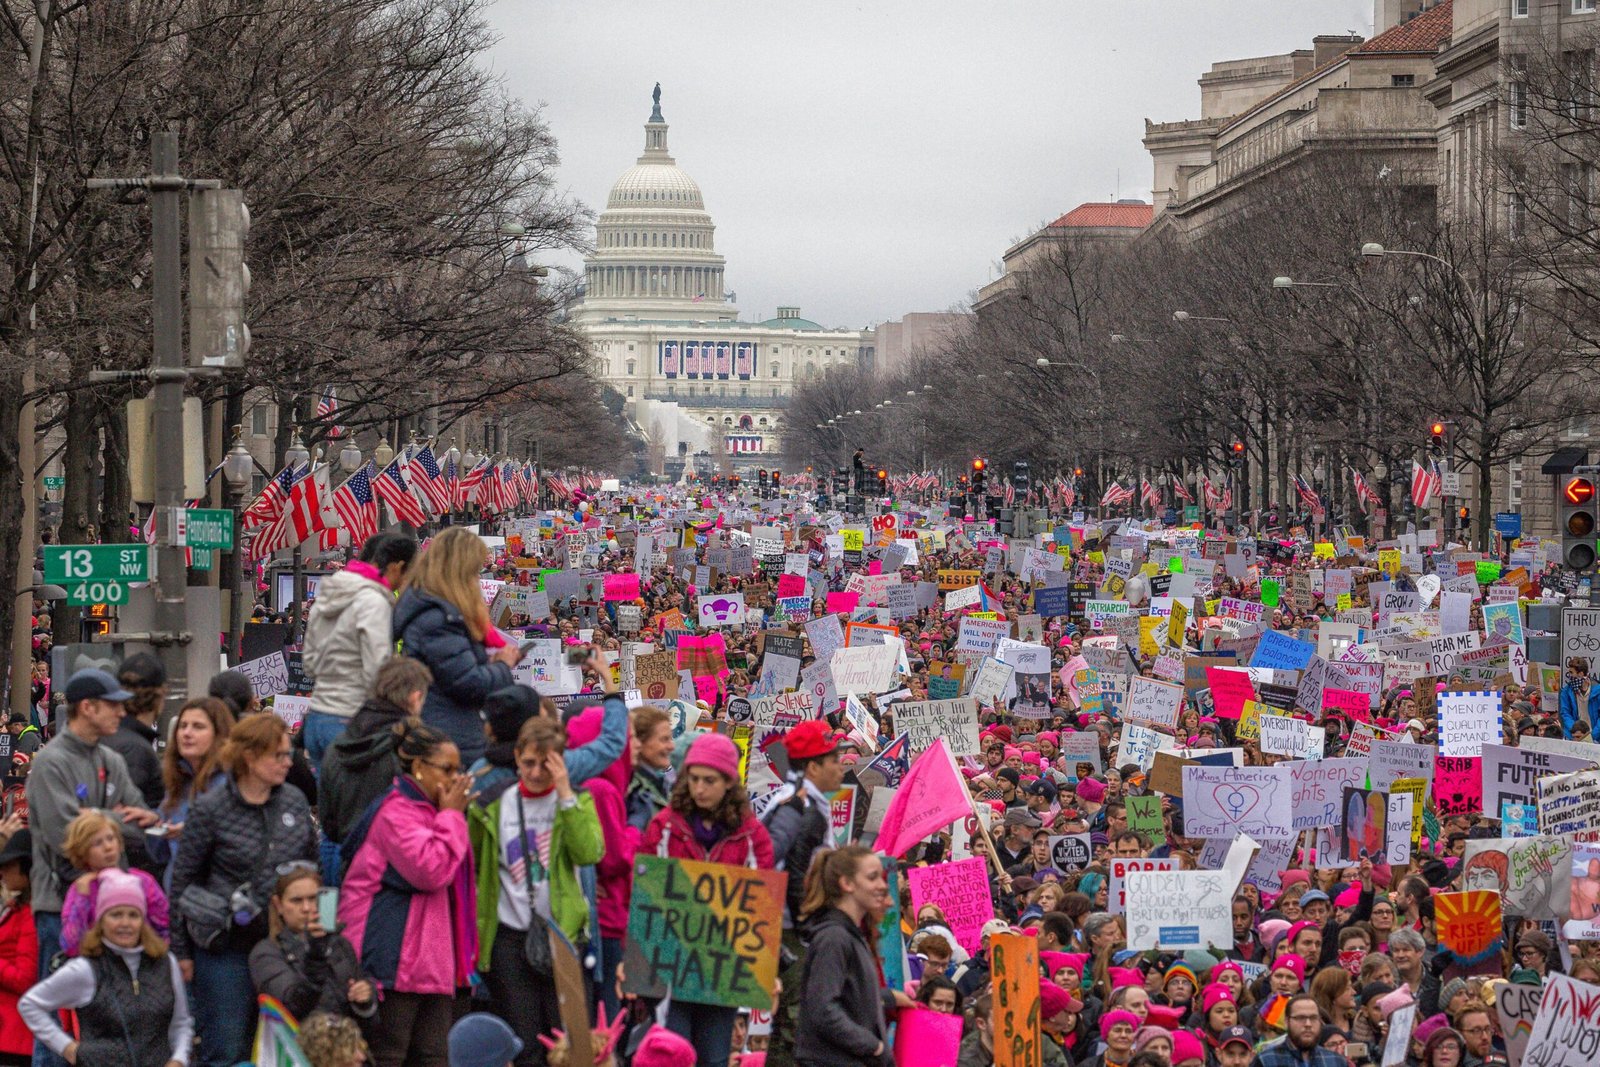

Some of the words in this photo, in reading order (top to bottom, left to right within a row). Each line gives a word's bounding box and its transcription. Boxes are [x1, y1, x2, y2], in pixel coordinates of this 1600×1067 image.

[46, 477, 54, 485] 12
[872, 514, 896, 532] HO
[59, 549, 94, 578] 13
[120, 550, 140, 562] ST
[194, 549, 210, 567] 1300
[765, 555, 786, 563] RESIST
[1110, 560, 1130, 570] GRAB
[120, 564, 142, 575] NW
[938, 575, 979, 586] RESIST
[1356, 572, 1382, 584] LOVE
[73, 582, 122, 602] 400
[782, 597, 810, 605] FREEDOM
[1087, 602, 1129, 613] PATRIARCHY
[1222, 598, 1241, 609] WE
[1244, 603, 1263, 614] ARE
[1228, 608, 1257, 622] BETTER
[1566, 613, 1598, 627] THRU
[966, 620, 1006, 630] AMERICANS
[964, 628, 980, 638] WILL
[622, 643, 638, 656] THE
[774, 637, 794, 648] HATE
[966, 639, 990, 648] RULED
[1267, 634, 1301, 652] Checks
[1430, 637, 1456, 654] HEAR
[1456, 634, 1473, 650] ME
[636, 654, 665, 664] RESPETA
[1082, 648, 1104, 657] WHEN
[1105, 650, 1128, 668] SHE
[1262, 645, 1302, 666] balances
[1462, 646, 1500, 663] WOMEN
[1514, 646, 1524, 658] A
[258, 652, 284, 673] ARE
[1388, 660, 1399, 670] We
[250, 674, 268, 683] THE
[1311, 659, 1345, 688] MAKE
[1344, 664, 1361, 676] YOUR
[1362, 664, 1384, 678] TINY
[250, 672, 289, 699] TORM
[1352, 681, 1368, 692] OFF
[1368, 682, 1380, 694] MY
[1133, 696, 1154, 706] GREED
[1326, 692, 1366, 707] ETHICS
[754, 700, 776, 716] YOUR
[894, 703, 925, 718] WHEN
[929, 704, 945, 716] DID
[1446, 704, 1474, 715] MEN
[1476, 702, 1488, 714] OF
[896, 715, 948, 728] DOLLAR
[1260, 716, 1294, 732] DIVERSITY
[1297, 720, 1304, 734] IS
[1446, 718, 1490, 732] QUALITY
[1266, 730, 1308, 756] beautiful
[1352, 731, 1373, 744] DON'T
[1448, 732, 1490, 744] DEMAND
[1379, 745, 1399, 755] STOP
[1400, 746, 1429, 760] TRYING
[1448, 744, 1482, 756] WOME
[1380, 756, 1388, 764] TO
[1388, 757, 1414, 767] CONTROL
[1436, 756, 1472, 772] GRAB
[1520, 751, 1550, 766] THE
[1188, 767, 1220, 783] Making
[1224, 767, 1282, 782] America
[1538, 780, 1542, 799] I
[1543, 786, 1554, 798] AM
[1558, 782, 1570, 793] NO
[1572, 778, 1598, 790] LONGER
[1132, 800, 1157, 819] We
[1542, 815, 1546, 827] I
[1548, 808, 1576, 824] CANNOT
[1186, 818, 1230, 836] GREAT
[1262, 825, 1289, 836] 1776
[1553, 819, 1588, 836] CHANGING
[1063, 838, 1077, 848] END
[1055, 855, 1088, 864] SUPPRESSION
[1512, 842, 1538, 867] Pussy
[931, 864, 951, 878] THE
[955, 860, 982, 872] TRUE
[920, 869, 984, 890] GREATNESS
[1128, 874, 1186, 894] GOLDEN
[662, 864, 766, 914] LOVE
[922, 888, 937, 900] OF
[937, 888, 946, 898] A
[949, 880, 986, 896] NATION
[976, 892, 989, 902] ON
[1130, 893, 1192, 910] SHOWERS
[976, 901, 986, 912] OF
[1132, 909, 1170, 922] BRING
[636, 903, 769, 953] TRUMPS
[1450, 921, 1486, 938] RISE
[649, 945, 758, 994] HATE
